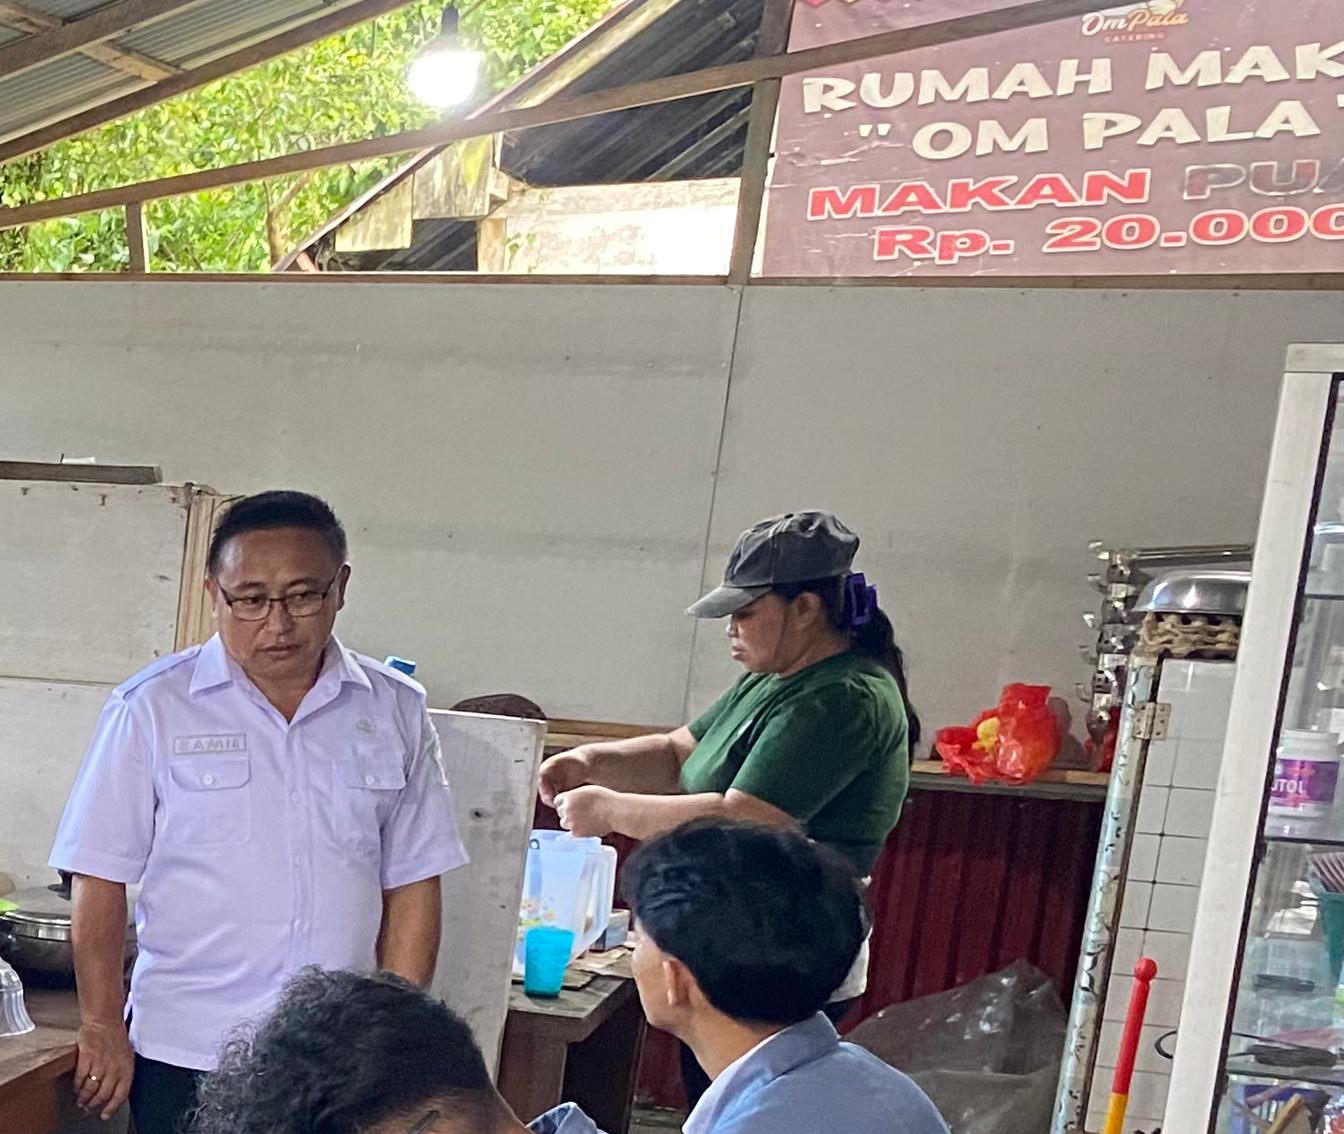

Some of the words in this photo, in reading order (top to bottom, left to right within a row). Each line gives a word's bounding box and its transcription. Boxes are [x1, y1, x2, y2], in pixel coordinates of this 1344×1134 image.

[802, 57, 1112, 115] RUMAH
[807, 168, 1152, 221] MAKAN
[872, 225, 1015, 266] Rp.
